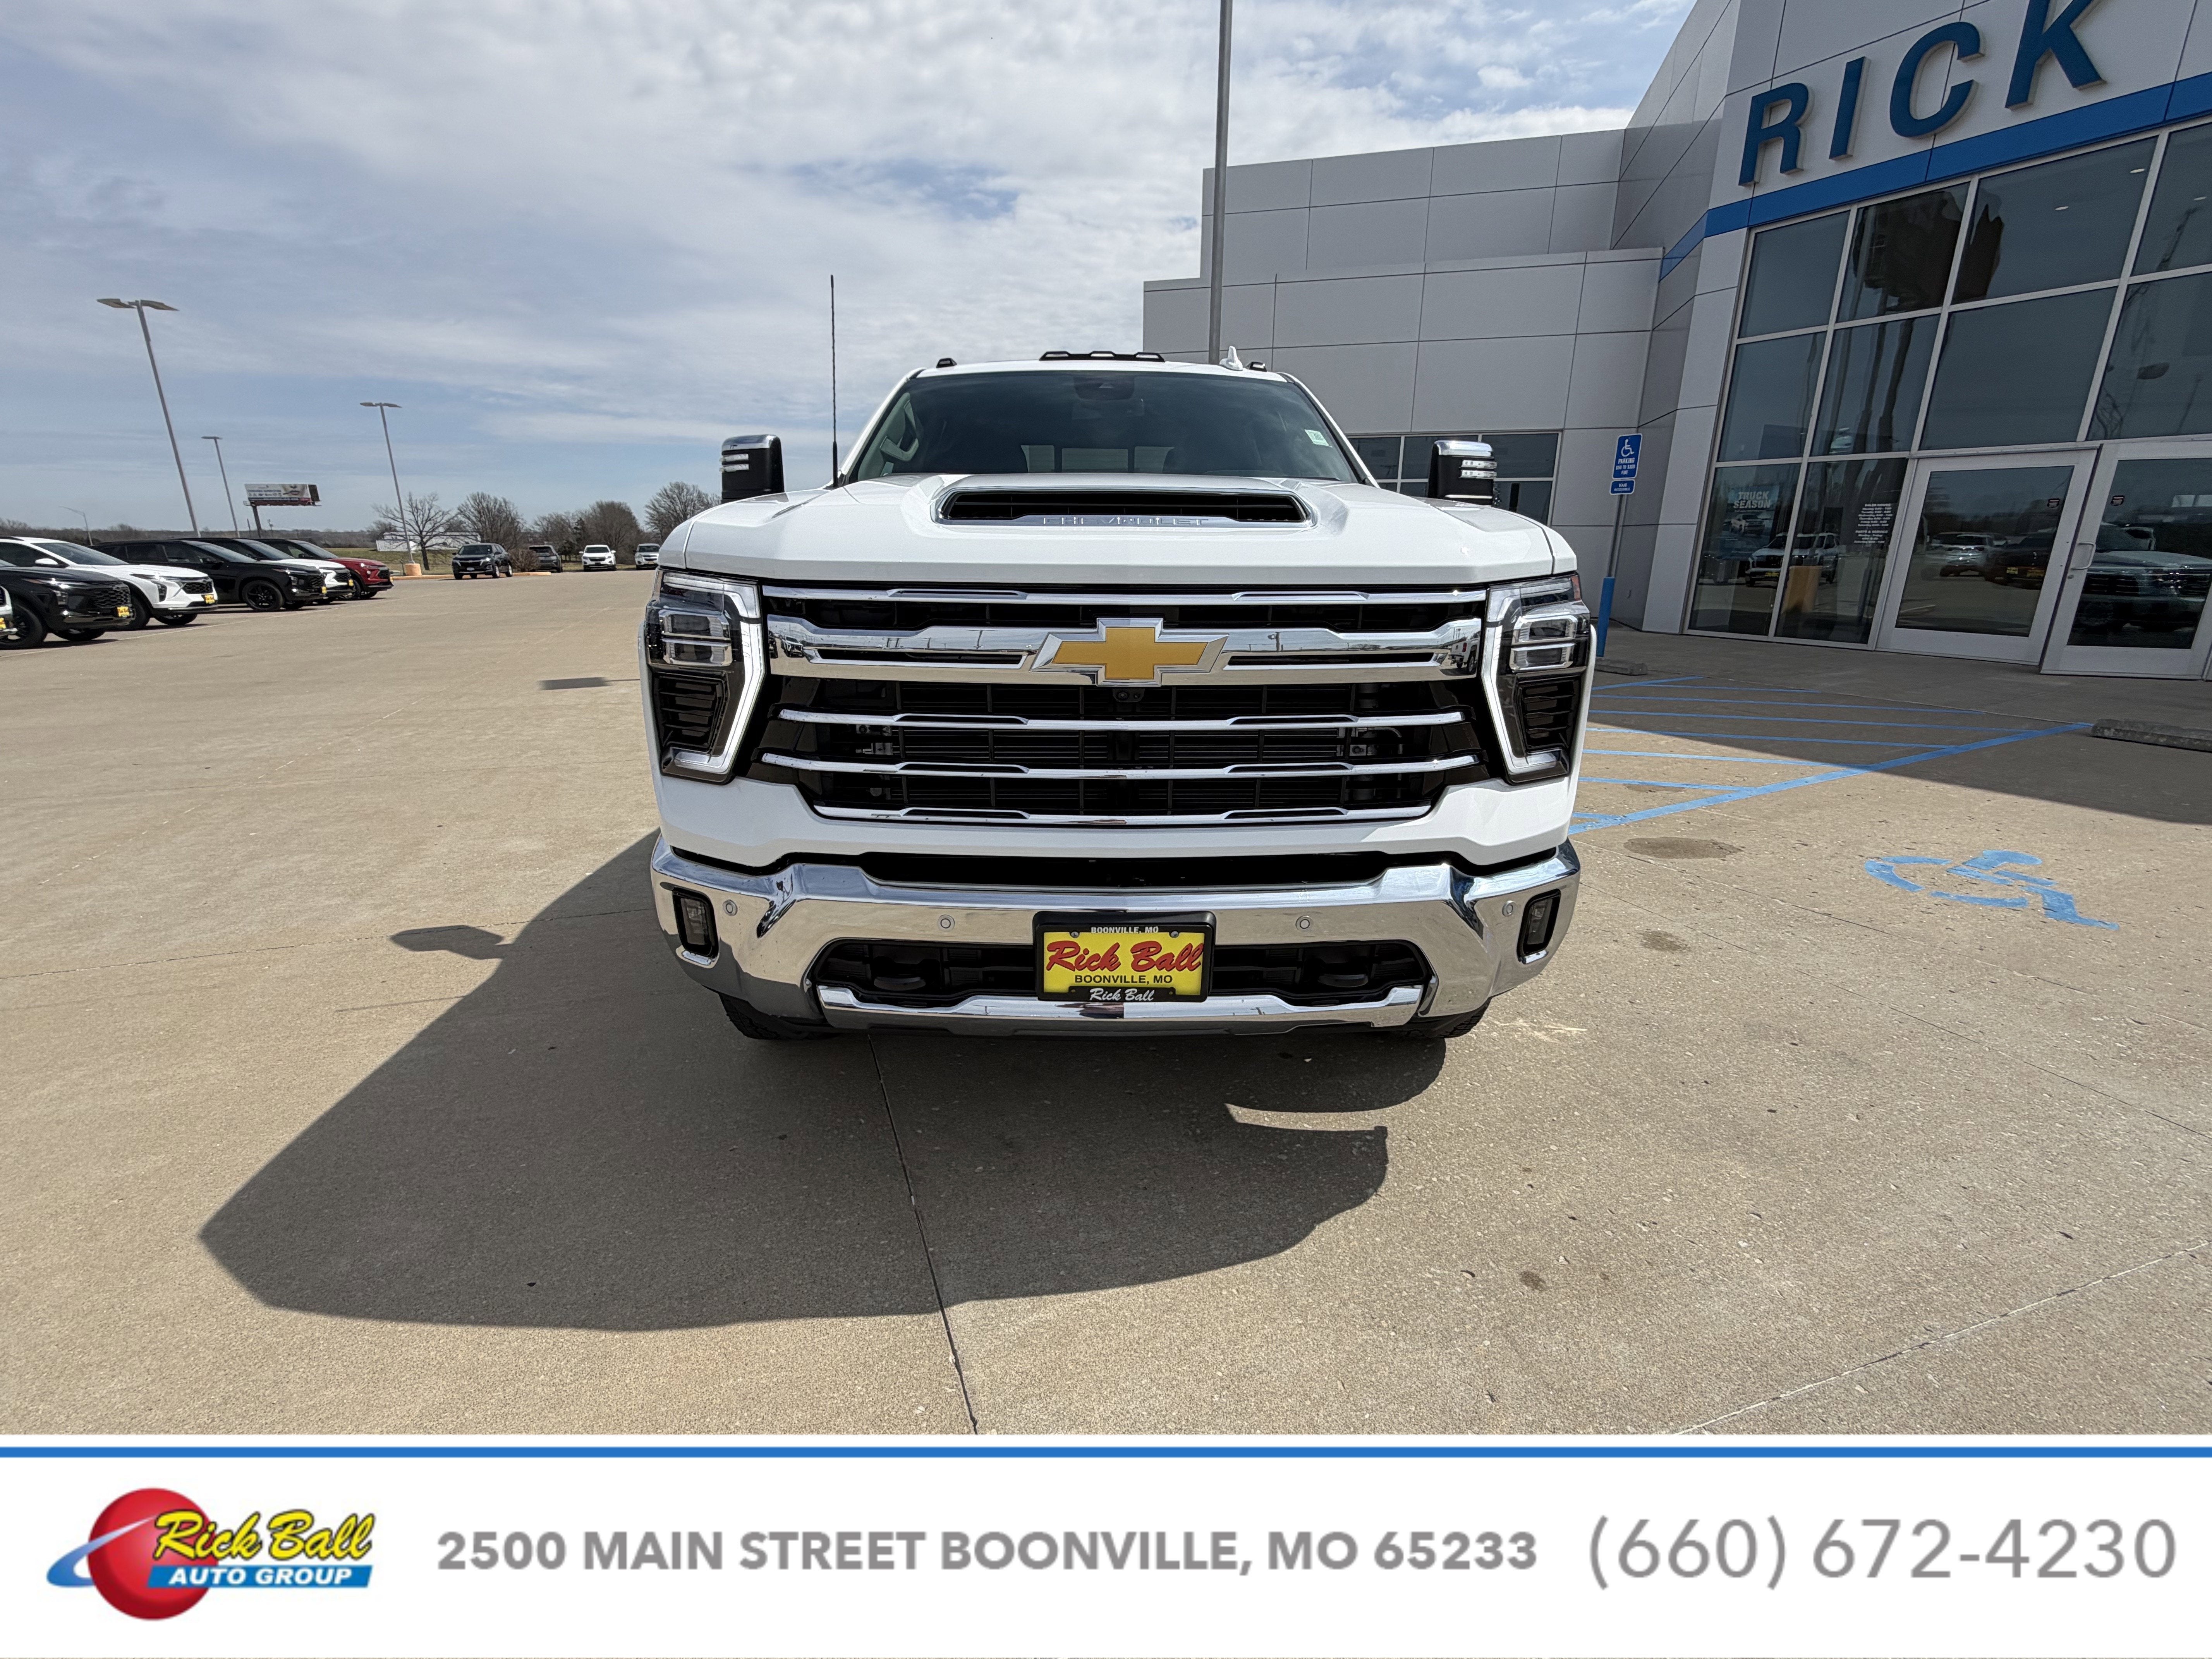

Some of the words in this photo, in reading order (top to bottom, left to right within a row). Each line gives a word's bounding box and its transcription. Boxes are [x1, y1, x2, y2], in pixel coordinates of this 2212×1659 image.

[1738, 0, 2106, 186] RICK
[1738, 491, 1769, 500] TRUCK
[1733, 500, 1771, 508] SEASON
[1046, 940, 1121, 972] Rick
[1130, 941, 1204, 972] Ball
[1075, 975, 1149, 984] BOONVILLE,
[1153, 975, 1173, 984] MO
[1089, 988, 1121, 1001] Rick
[1125, 989, 1155, 1001] Ball
